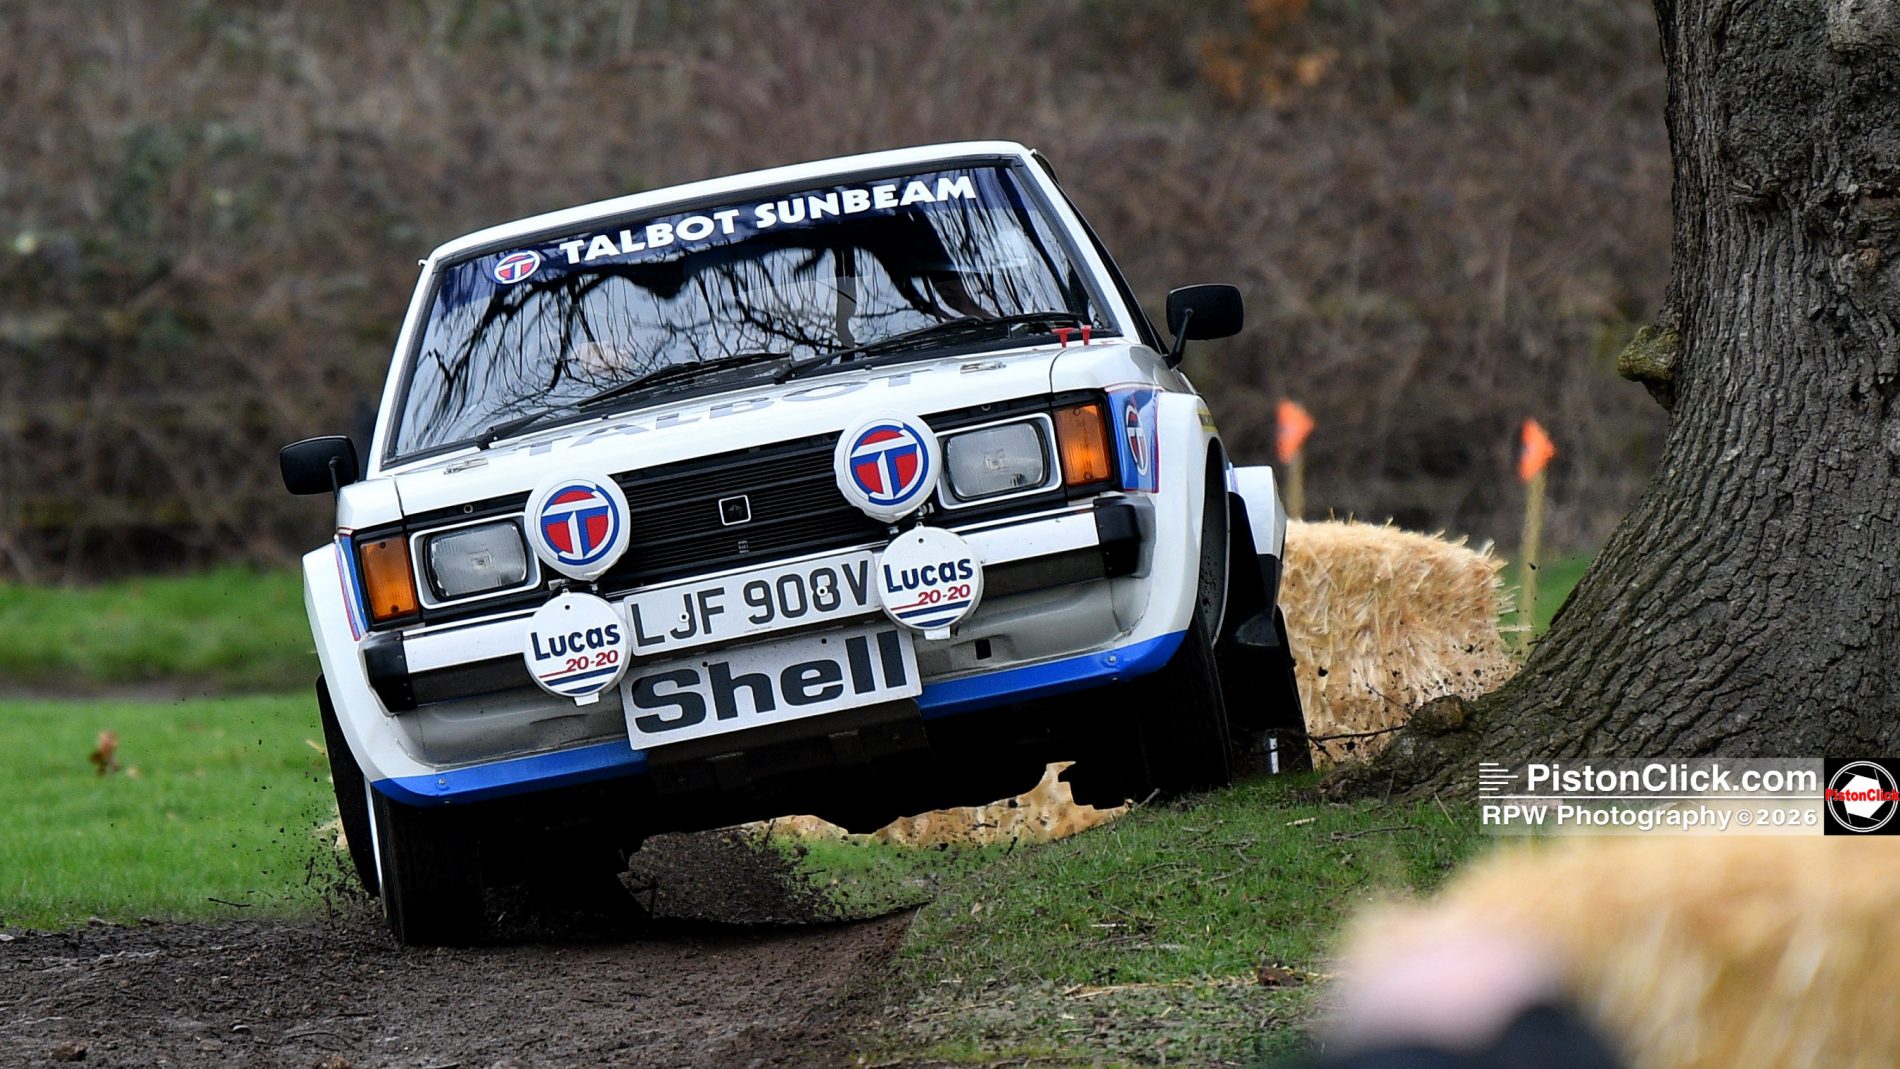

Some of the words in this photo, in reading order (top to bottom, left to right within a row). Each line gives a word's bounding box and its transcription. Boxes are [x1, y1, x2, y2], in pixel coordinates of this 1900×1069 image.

[560, 208, 740, 265] TALBOT
[754, 176, 977, 229] SUNBEAM
[884, 558, 974, 594] Lucas
[918, 583, 971, 606] 20-20
[631, 587, 726, 647] LJF
[743, 560, 869, 625] 908V
[531, 624, 621, 661] Lucas
[565, 650, 619, 672] 20-20
[631, 630, 908, 734] Shell
